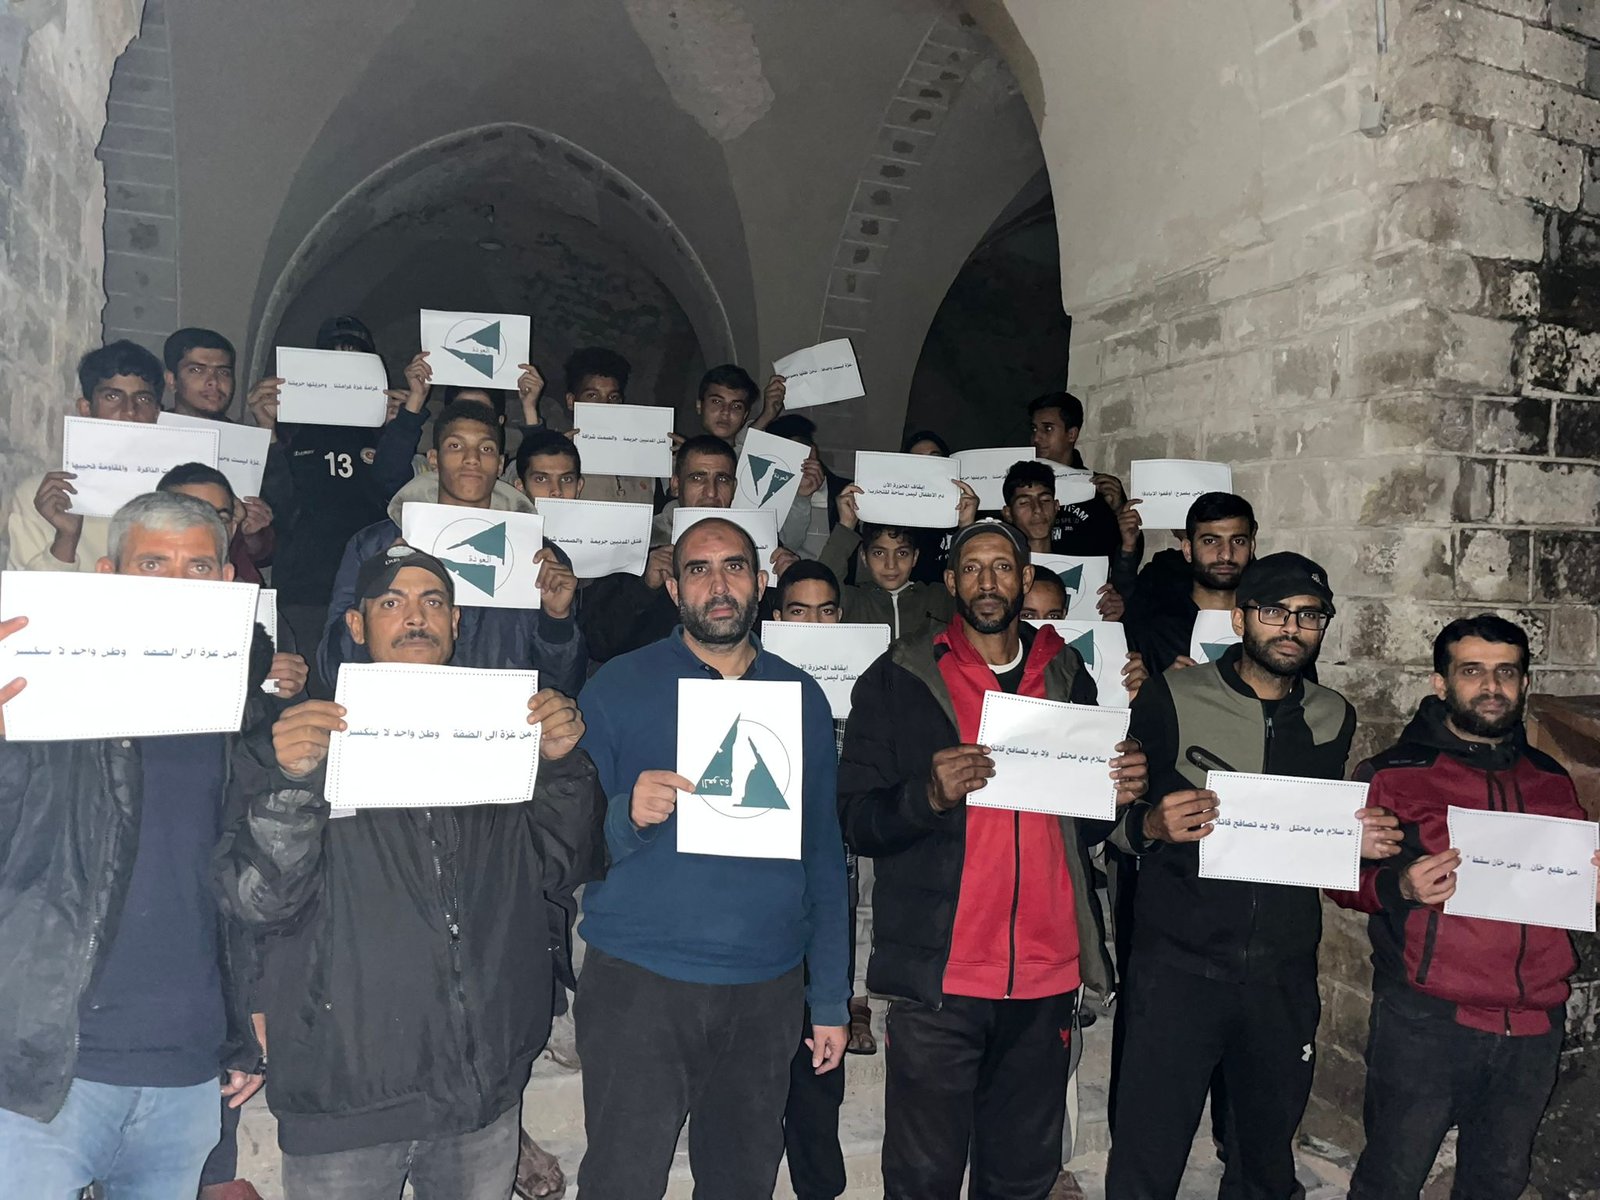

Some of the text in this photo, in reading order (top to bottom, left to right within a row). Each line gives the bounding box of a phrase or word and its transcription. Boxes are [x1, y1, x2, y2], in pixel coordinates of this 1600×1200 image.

[324, 451, 354, 478] 13
[590, 537, 608, 545] جريمة
[630, 537, 642, 545] قتل
[468, 554, 492, 564] العودة
[58, 646, 65, 655] لا
[71, 647, 96, 657] واحد
[808, 664, 829, 672] المجزرة
[823, 674, 839, 682] ليس
[347, 727, 379, 739] ينكسر
[383, 728, 390, 737] لا
[393, 729, 415, 739] واحد
[418, 729, 440, 739] وطن
[452, 729, 482, 739] الضفة
[485, 730, 498, 741] الى
[500, 729, 516, 740] غزة
[1006, 746, 1029, 756] تصافح
[1030, 750, 1039, 758] يد
[1041, 749, 1049, 758] ولا
[1078, 755, 1089, 763] مع
[1090, 755, 1107, 764] سلام
[701, 775, 730, 789] العودة
[1233, 820, 1258, 829] تصافح
[1270, 822, 1280, 831] ولا
[1313, 827, 1324, 836] مع
[1326, 827, 1345, 837] سلام
[1491, 859, 1505, 867] خان
[1506, 862, 1521, 870] ومن
[1547, 866, 1564, 875] طبع
